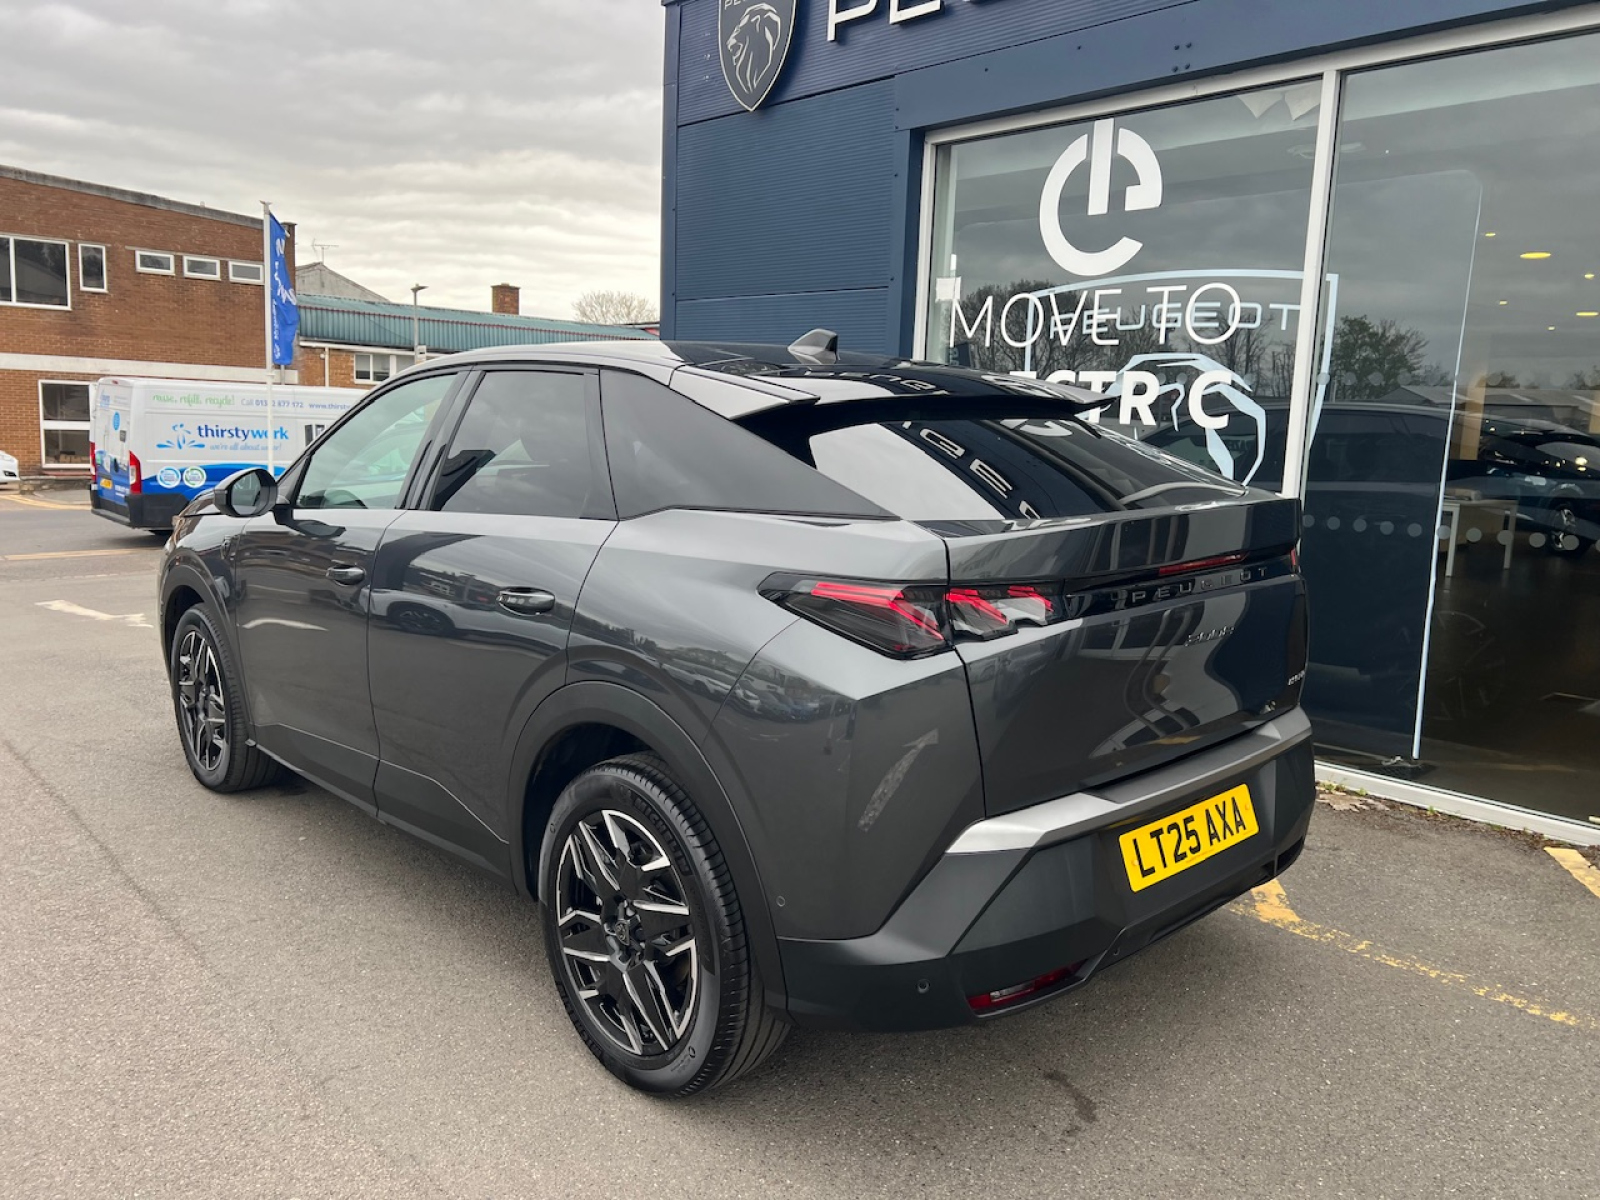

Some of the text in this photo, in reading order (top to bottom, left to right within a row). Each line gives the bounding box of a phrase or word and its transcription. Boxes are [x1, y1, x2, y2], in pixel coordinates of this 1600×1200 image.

[949, 281, 1241, 348] MOVE TO
[254, 399, 276, 407] 0132
[1132, 567, 1267, 603] PEUGEOT
[1133, 796, 1247, 878] LT25 AXA
